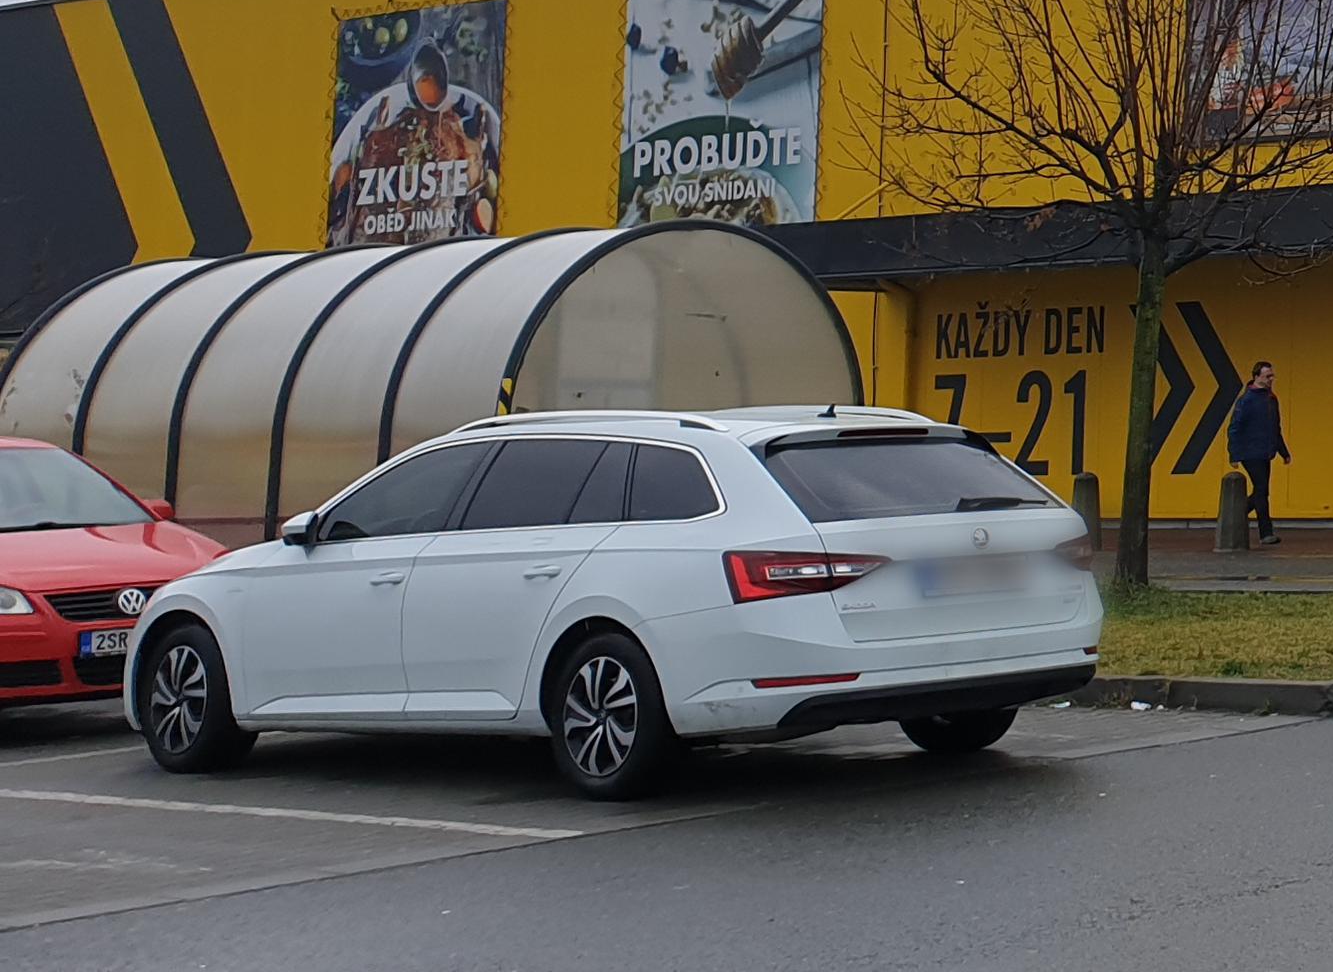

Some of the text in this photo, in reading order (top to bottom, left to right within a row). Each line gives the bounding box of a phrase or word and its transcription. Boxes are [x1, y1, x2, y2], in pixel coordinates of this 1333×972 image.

[633, 118, 801, 178] PROBUĎTE
[356, 159, 469, 206] ZKUSTE
[653, 182, 700, 207] SVOU
[364, 208, 457, 235] OBĚD JINAK
[935, 299, 1106, 359] KAŽDÝ DEN
